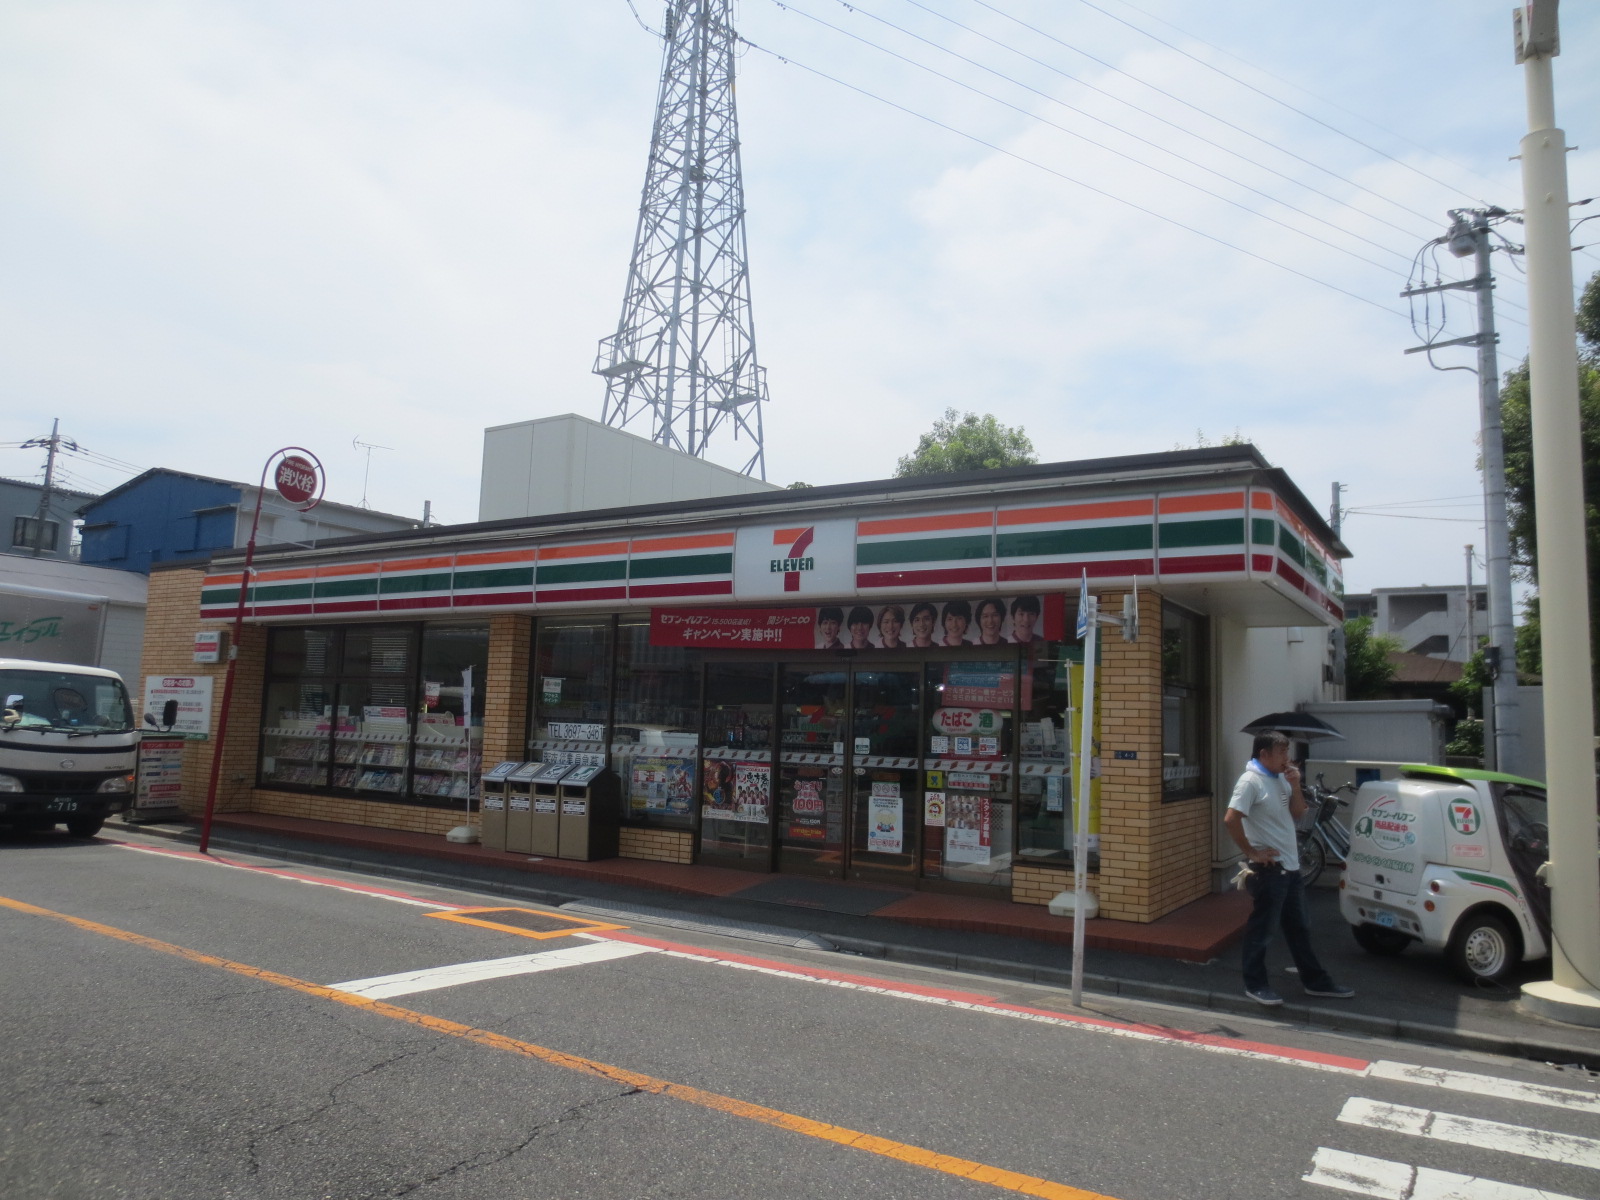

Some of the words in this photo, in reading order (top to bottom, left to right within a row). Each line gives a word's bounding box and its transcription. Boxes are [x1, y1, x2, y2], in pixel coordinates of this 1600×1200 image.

[279, 466, 314, 493] 消火栓
[773, 526, 814, 592] 7
[683, 628, 783, 642] キャンペーン実施中!!
[941, 711, 973, 727] たばこ
[979, 712, 994, 728] 酒
[549, 723, 562, 738] TEL
[793, 798, 824, 811] 100円
[1372, 808, 1417, 822] セブン-イレブン
